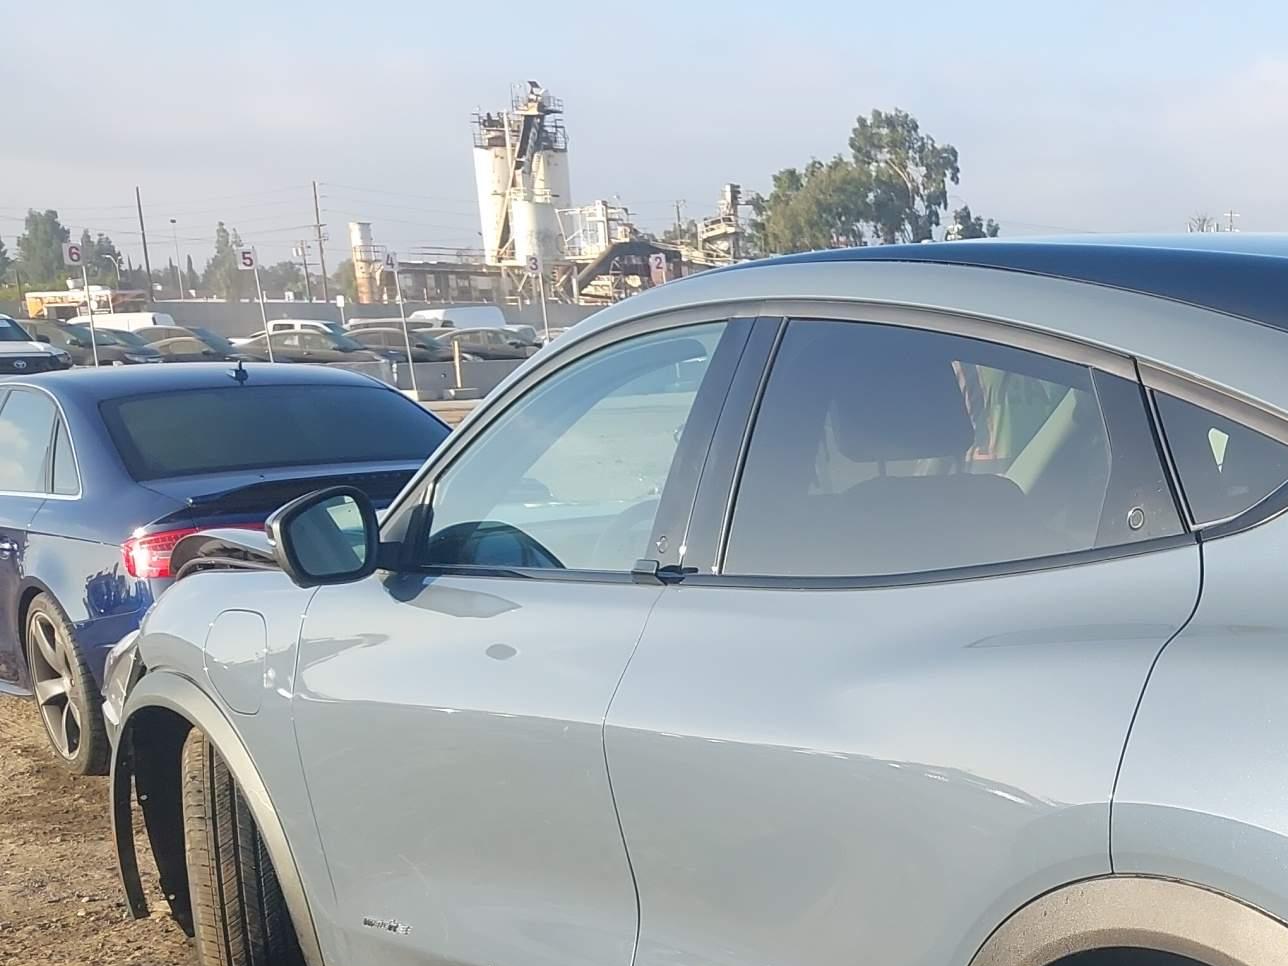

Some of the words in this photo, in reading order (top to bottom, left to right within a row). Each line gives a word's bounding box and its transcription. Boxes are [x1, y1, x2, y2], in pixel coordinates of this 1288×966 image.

[69, 246, 80, 262] 6
[242, 251, 253, 267] 5
[386, 254, 395, 270] 4
[529, 256, 539, 271] 3
[655, 256, 664, 271] 2
